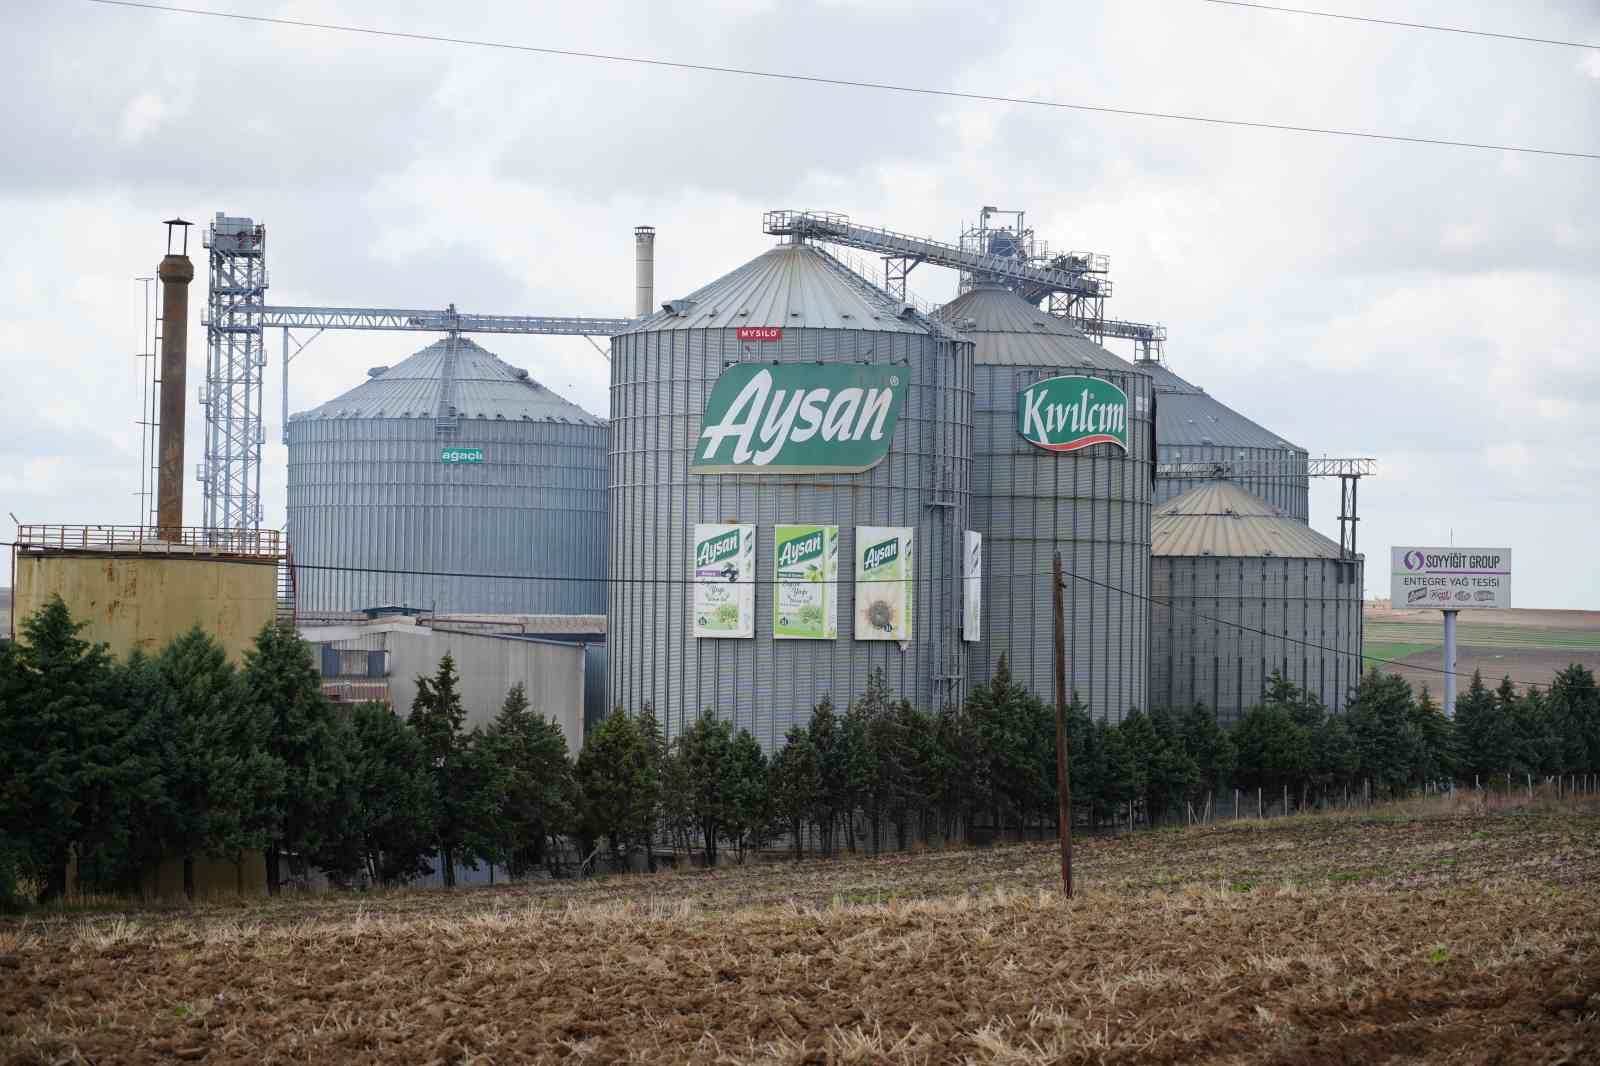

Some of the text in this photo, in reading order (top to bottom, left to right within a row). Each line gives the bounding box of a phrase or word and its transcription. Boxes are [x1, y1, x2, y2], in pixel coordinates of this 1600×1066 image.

[702, 368, 894, 466] Aysan
[698, 534, 738, 566] Aysan
[780, 536, 822, 566] Aysan
[864, 541, 897, 569] Aysan
[1469, 555, 1500, 569] GROUP
[1403, 576, 1447, 586] ENTEGRE
